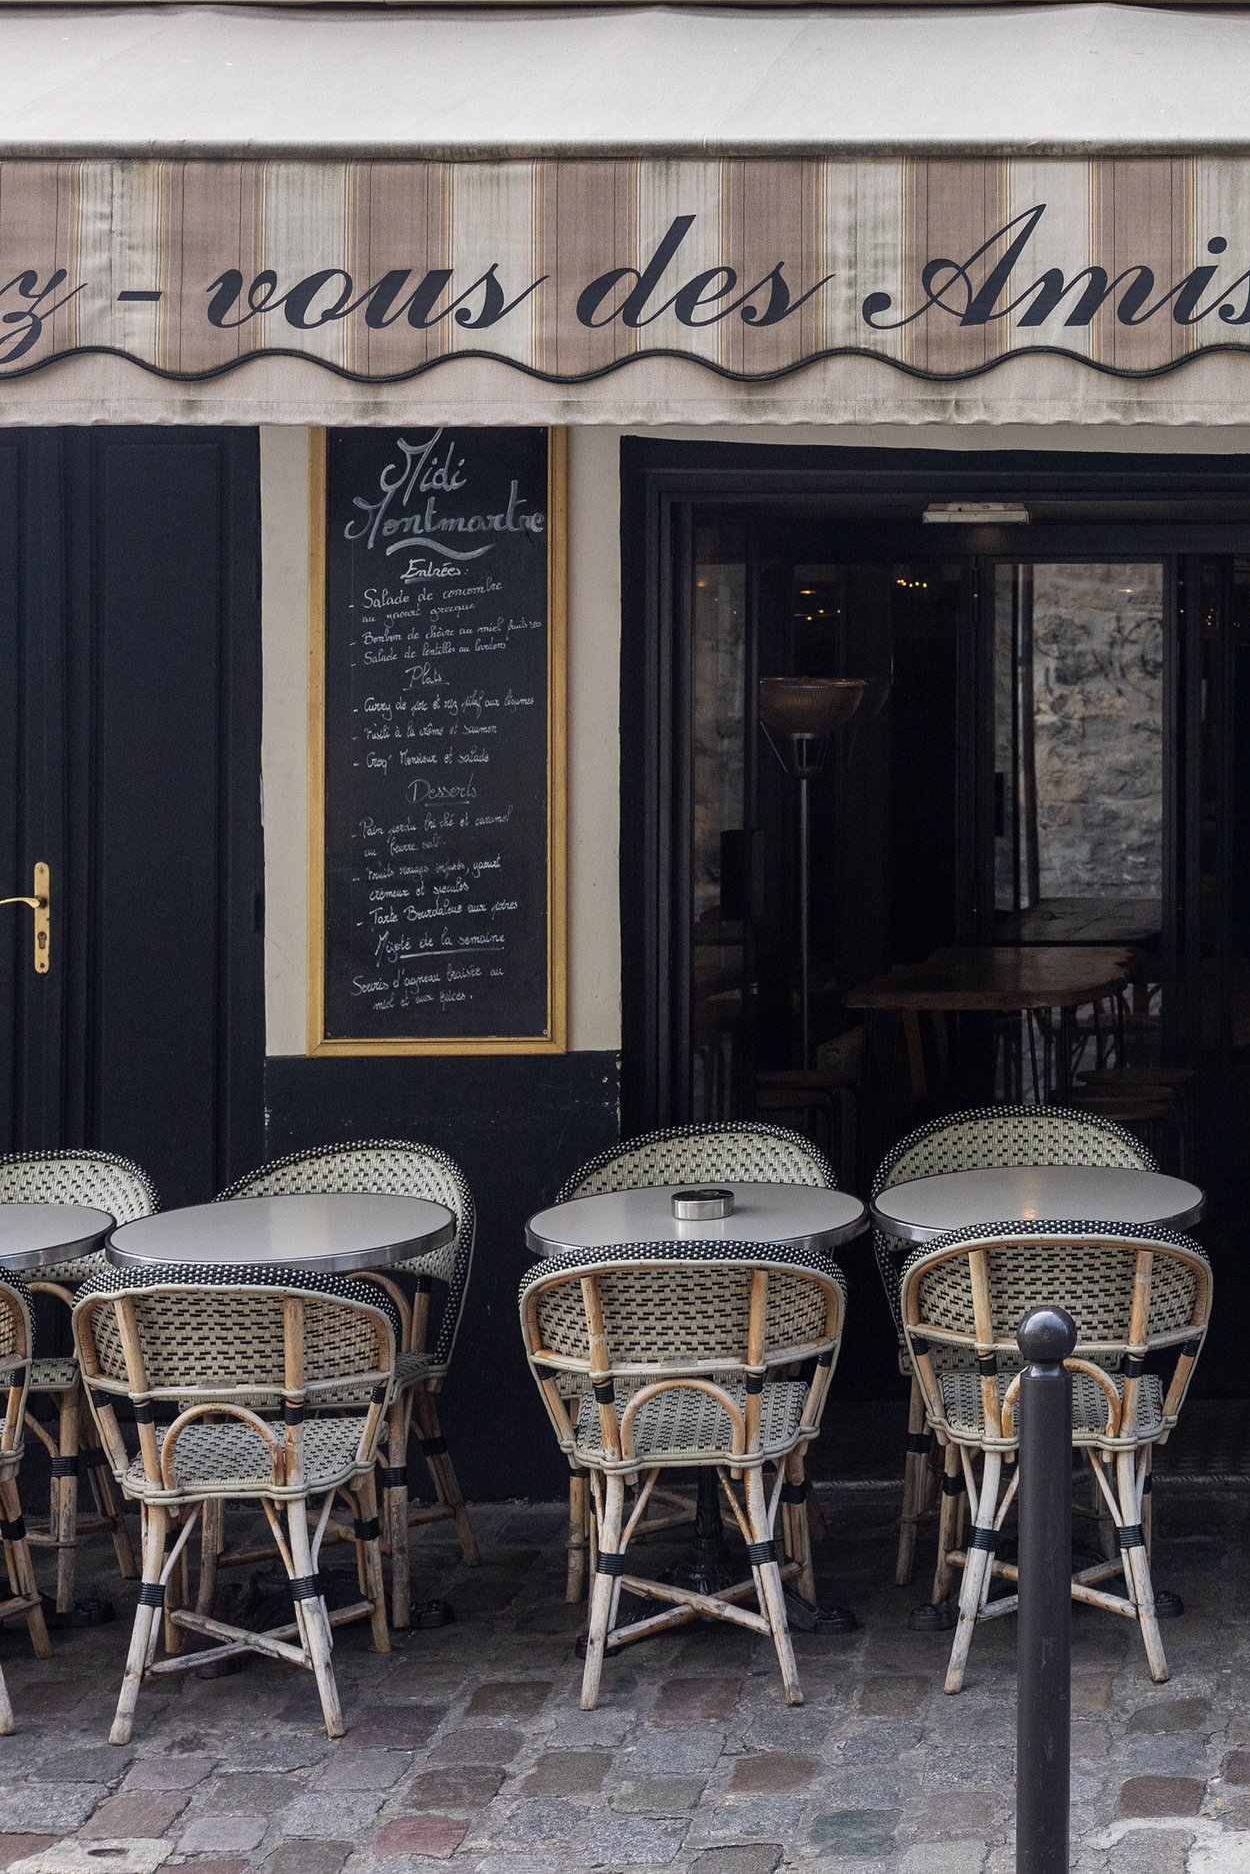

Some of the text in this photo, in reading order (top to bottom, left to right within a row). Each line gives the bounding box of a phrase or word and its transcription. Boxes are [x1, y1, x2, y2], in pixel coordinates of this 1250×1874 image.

[575, 213, 837, 329] des
[380, 427, 468, 506] Midi
[344, 480, 546, 550] Montmartre
[362, 576, 503, 609] Salade de concombre
[362, 615, 377, 624] au
[384, 603, 422, 628] yaourt
[407, 628, 420, 641] de
[425, 625, 455, 640] chèvre
[459, 627, 474, 636] au
[477, 617, 504, 633] miel
[363, 637, 507, 665] Salade de lentilles au lardons
[405, 662, 443, 688] Plats
[363, 697, 392, 721] Curry
[395, 696, 407, 711] de
[433, 693, 441, 710] et
[484, 699, 500, 707] aux
[504, 688, 534, 713] légumes
[395, 725, 402, 738] à
[407, 720, 416, 738] la
[462, 725, 498, 735] saumon
[400, 748, 438, 766] Monsieur
[444, 746, 453, 764] et
[458, 745, 490, 763] salade
[406, 773, 478, 804] Desserts
[359, 817, 385, 839] Pain
[386, 817, 417, 844] perdu
[460, 811, 469, 827] et
[475, 805, 514, 827] caramel
[390, 836, 419, 856] beurre
[399, 864, 430, 882] rouges
[472, 853, 501, 878] yaourt
[416, 879, 425, 897] et
[369, 898, 518, 925] Tarte Bourdaloue aux poires
[374, 926, 505, 968] Mijoté de la semaine
[351, 963, 504, 996] Souris d'agneau braisée au
[373, 997, 395, 1011] miel
[400, 991, 409, 1007] et
[415, 994, 435, 1003] aux
